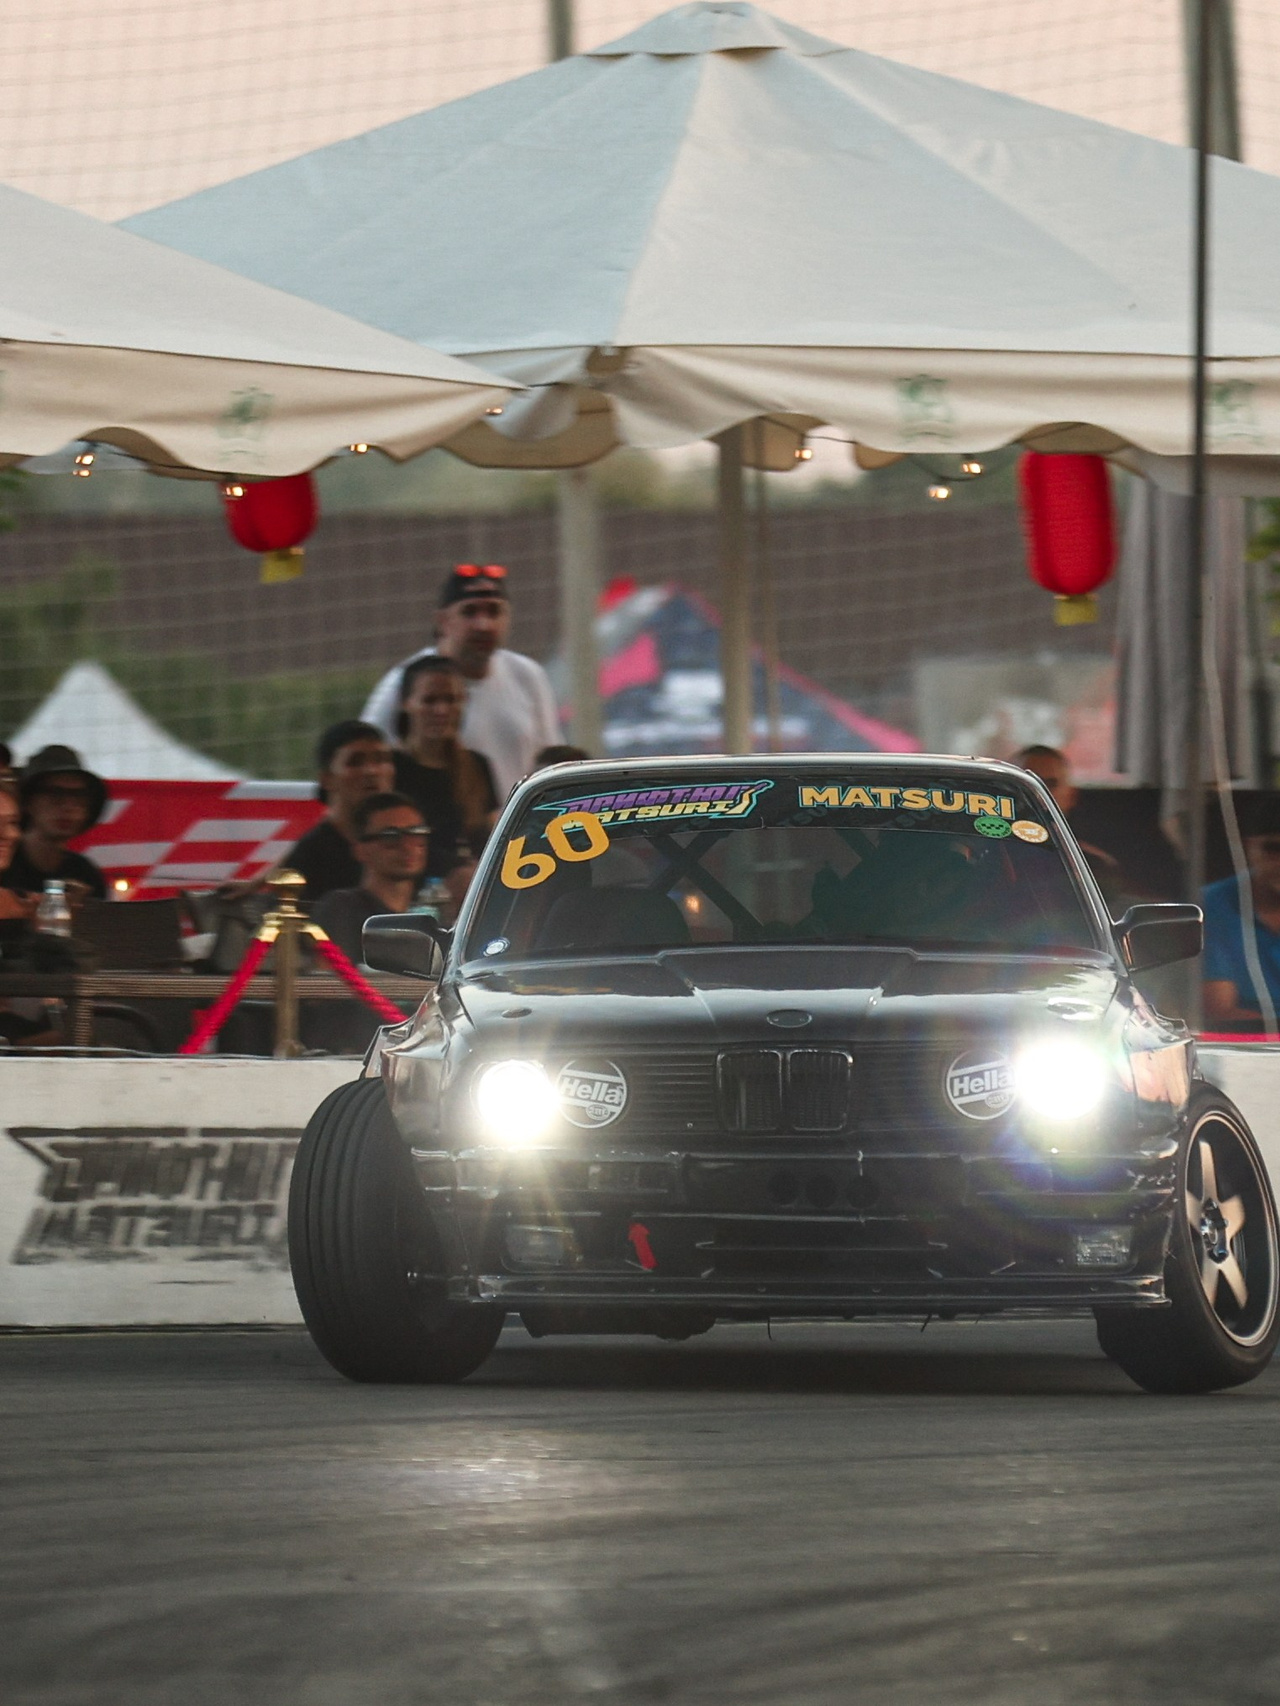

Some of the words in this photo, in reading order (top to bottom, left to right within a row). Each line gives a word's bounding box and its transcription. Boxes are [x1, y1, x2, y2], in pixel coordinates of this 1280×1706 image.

[799, 786, 1016, 820] MATSURI
[501, 811, 610, 889] 60
[560, 1077, 622, 1104] Hella
[953, 1069, 1013, 1097] Hella
